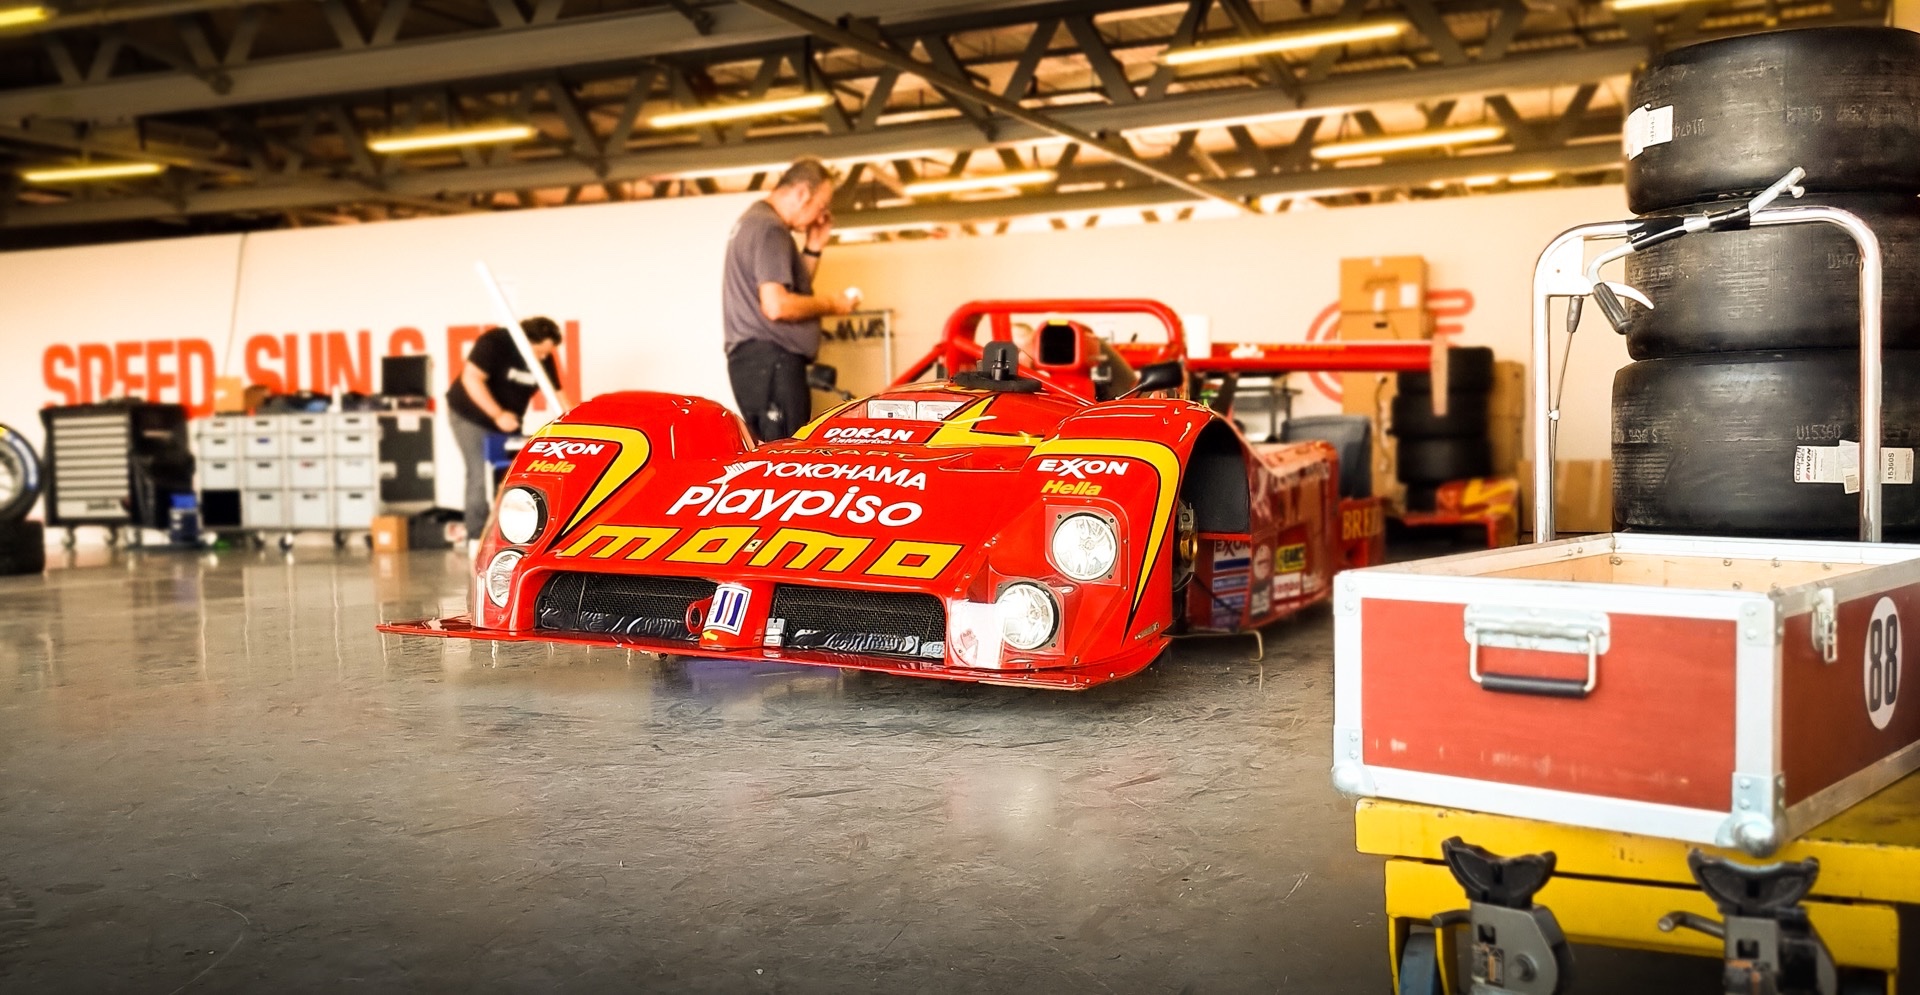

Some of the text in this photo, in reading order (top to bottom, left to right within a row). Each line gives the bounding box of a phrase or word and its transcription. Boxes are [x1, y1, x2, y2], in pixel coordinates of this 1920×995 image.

[42, 338, 216, 420] SPEED
[823, 427, 915, 442] DORAN
[528, 440, 605, 459] EXXON
[525, 460, 577, 473] Hella
[763, 461, 927, 490] YOKOHAMA
[1037, 457, 1129, 479] EXXON
[1040, 480, 1102, 495] Hella
[665, 485, 923, 527] Playpiso
[1869, 613, 1898, 713] 88
